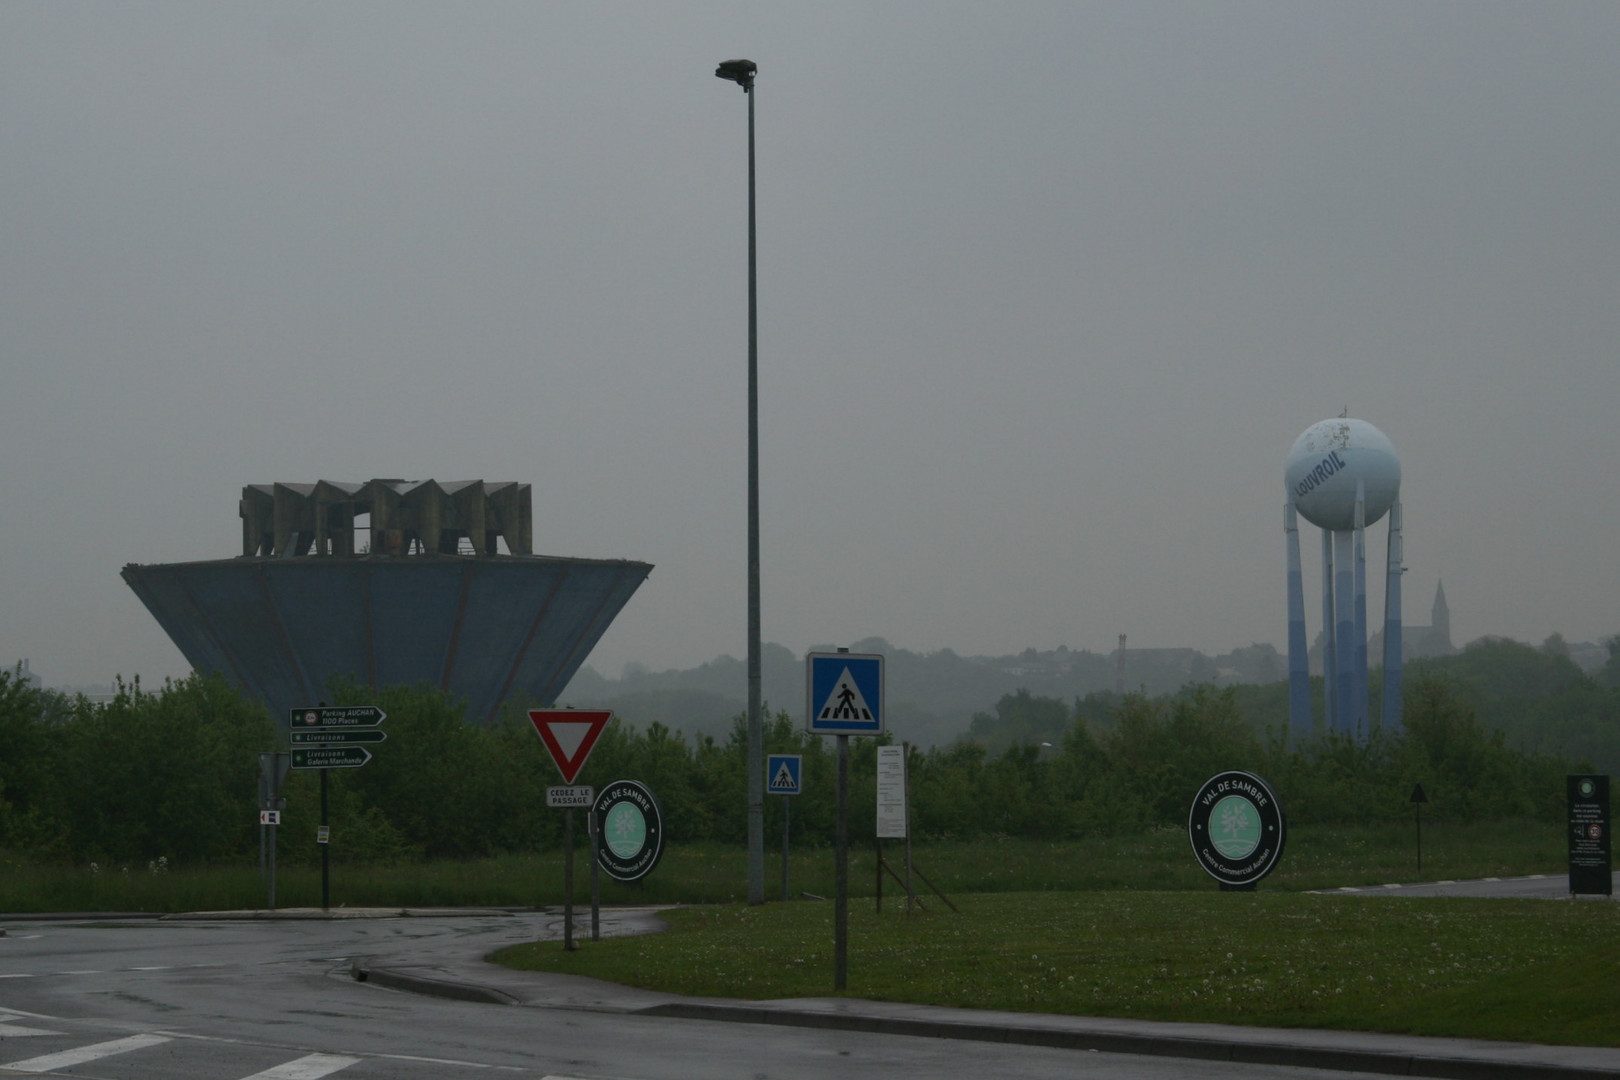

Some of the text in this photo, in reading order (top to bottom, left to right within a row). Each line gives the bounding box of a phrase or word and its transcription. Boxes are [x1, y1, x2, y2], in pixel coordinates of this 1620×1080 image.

[1295, 451, 1346, 497] LOUVROIL
[600, 788, 650, 812] VAL DE SAMBRE
[1202, 780, 1268, 808] VAL DE SAMBRE
[1202, 848, 1270, 876] Centre Commercial Auchan
